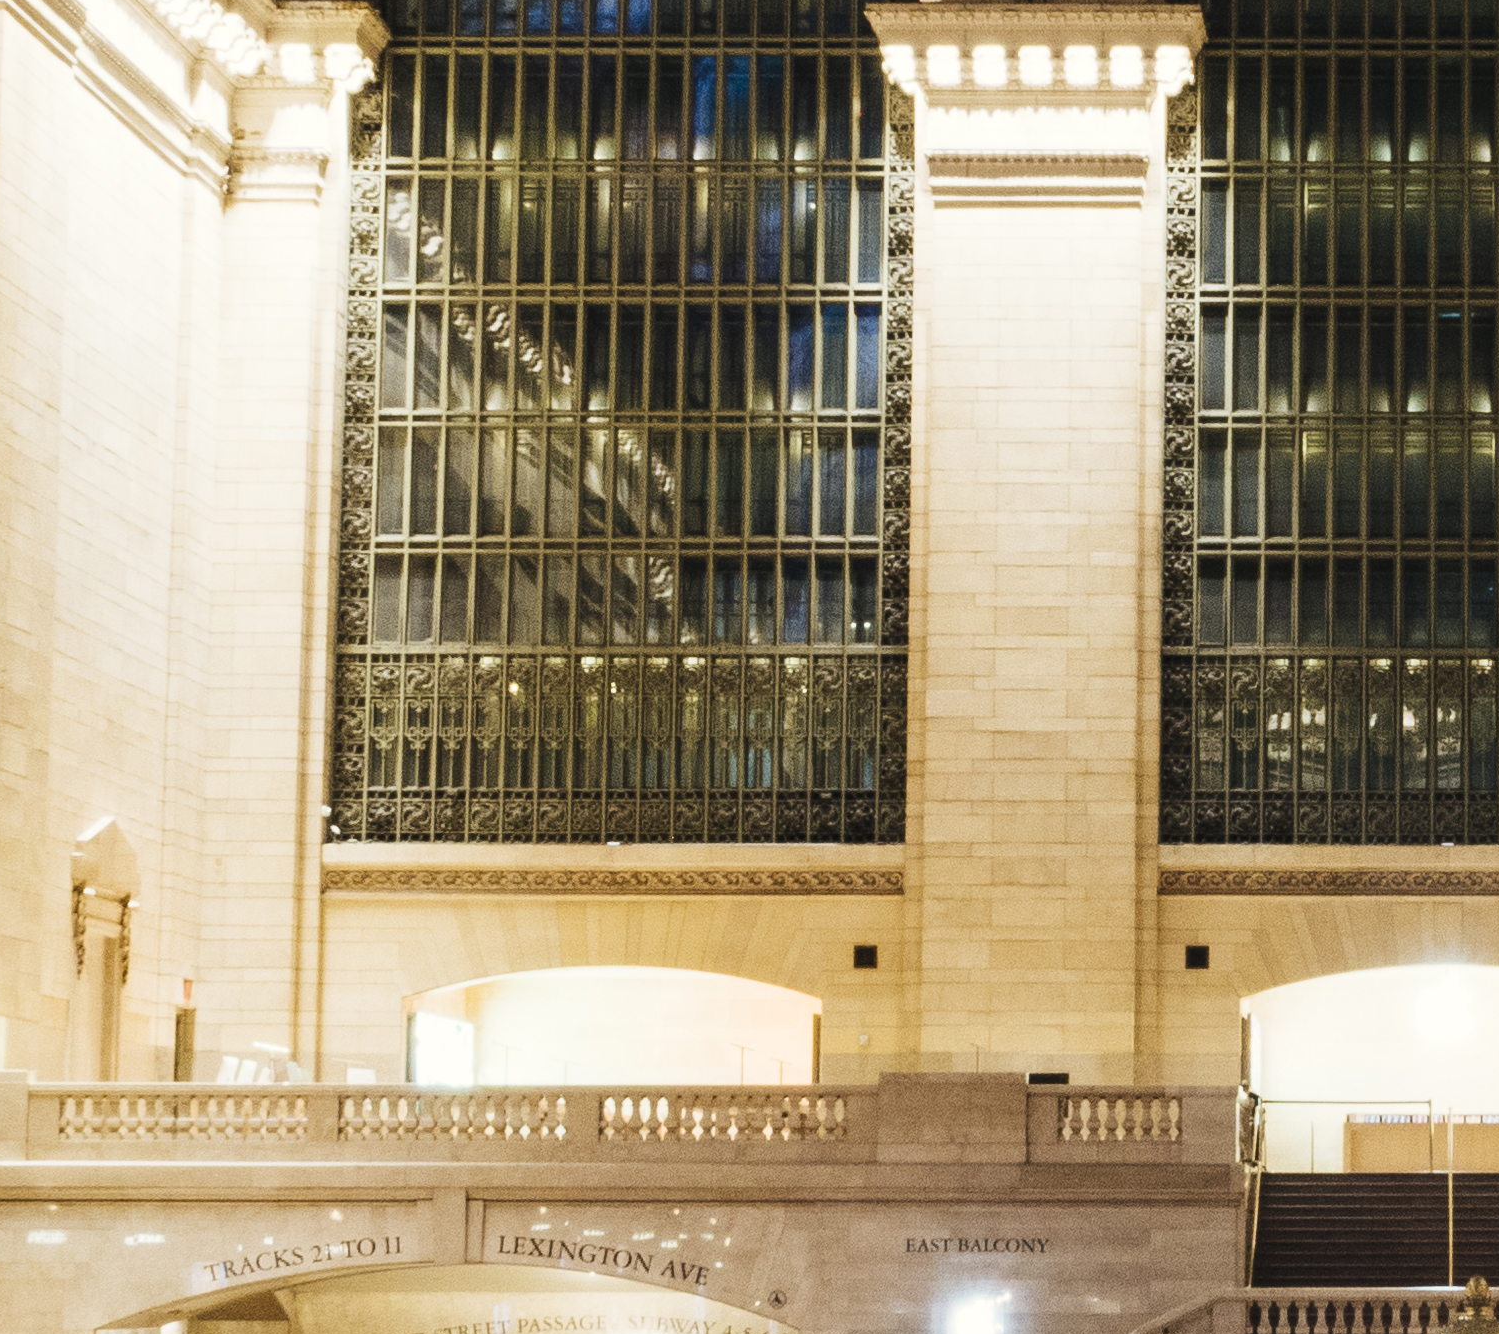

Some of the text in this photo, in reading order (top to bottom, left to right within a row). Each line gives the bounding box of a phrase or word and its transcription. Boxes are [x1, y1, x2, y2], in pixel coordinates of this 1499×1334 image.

[203, 1236, 402, 1282] TRACKS 21 TO 11
[498, 1235, 710, 1286] LEXINGTON AVE
[906, 1238, 1050, 1253] EAST BALCONY
[517, 1314, 608, 1334] PASSAGE
